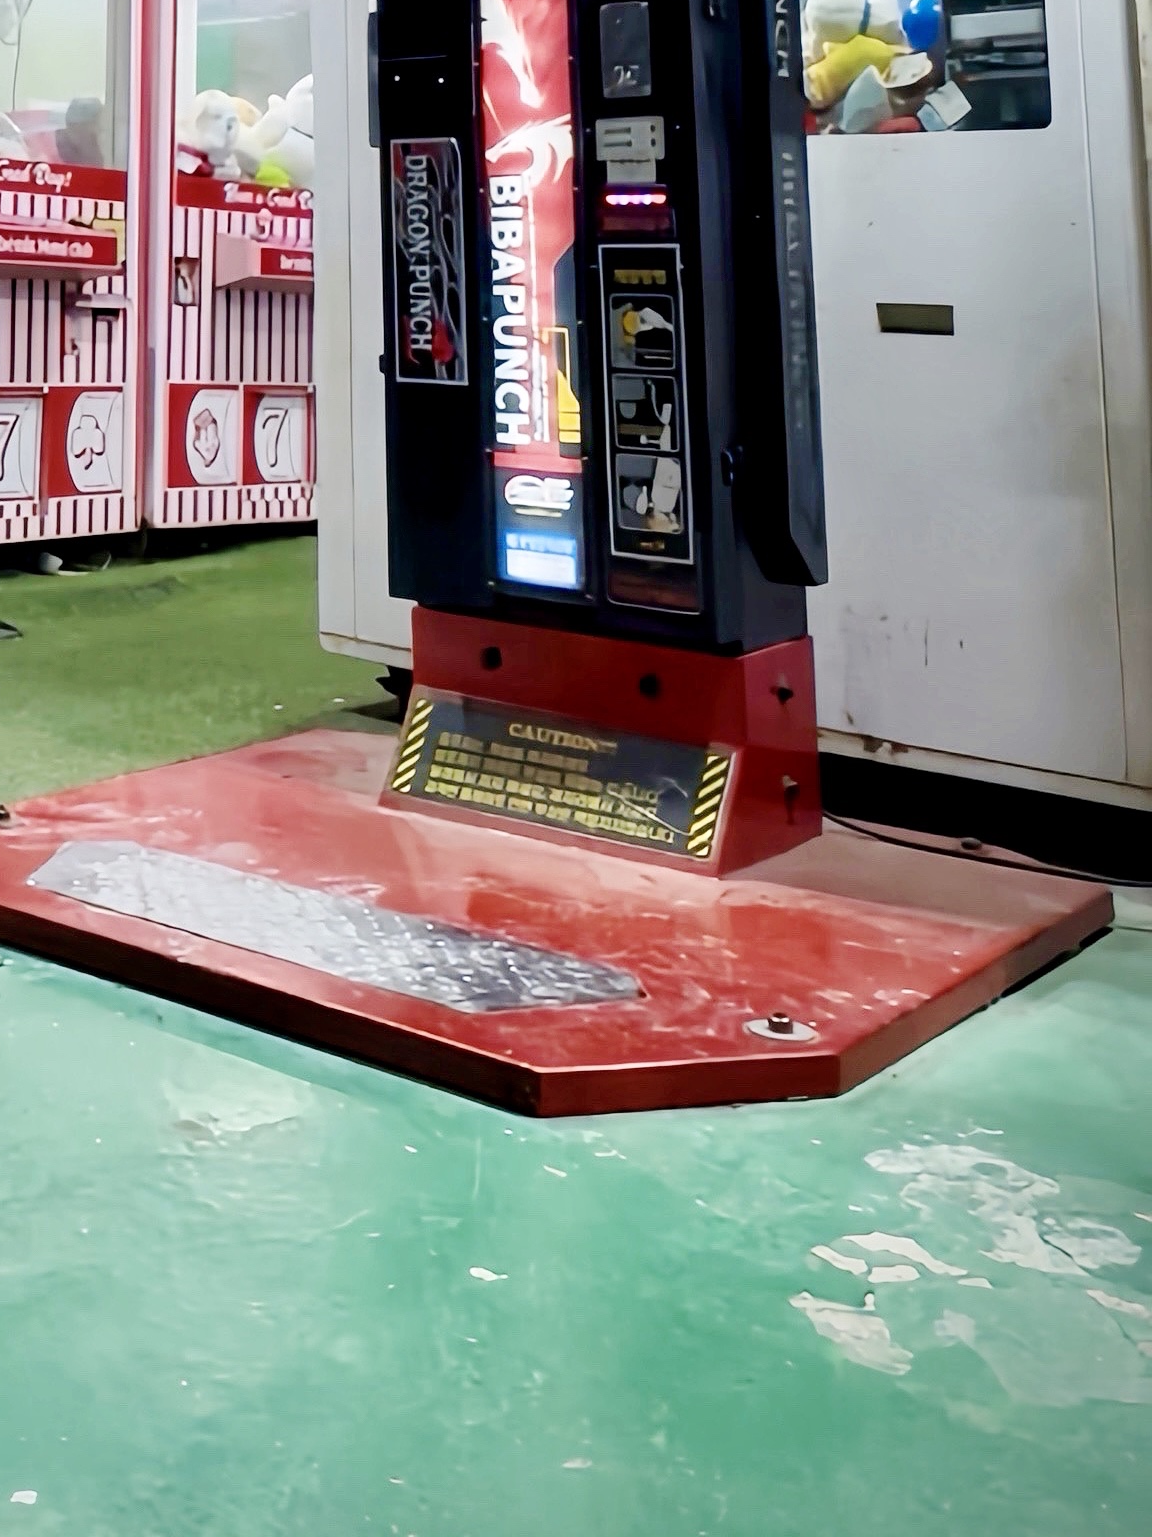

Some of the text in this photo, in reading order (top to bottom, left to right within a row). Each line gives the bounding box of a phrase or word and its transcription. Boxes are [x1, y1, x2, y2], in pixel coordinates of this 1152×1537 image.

[405, 154, 433, 352] DRAGON PUNCH
[488, 174, 531, 446] BIBAPUNCH
[508, 722, 598, 752] CAUTION
